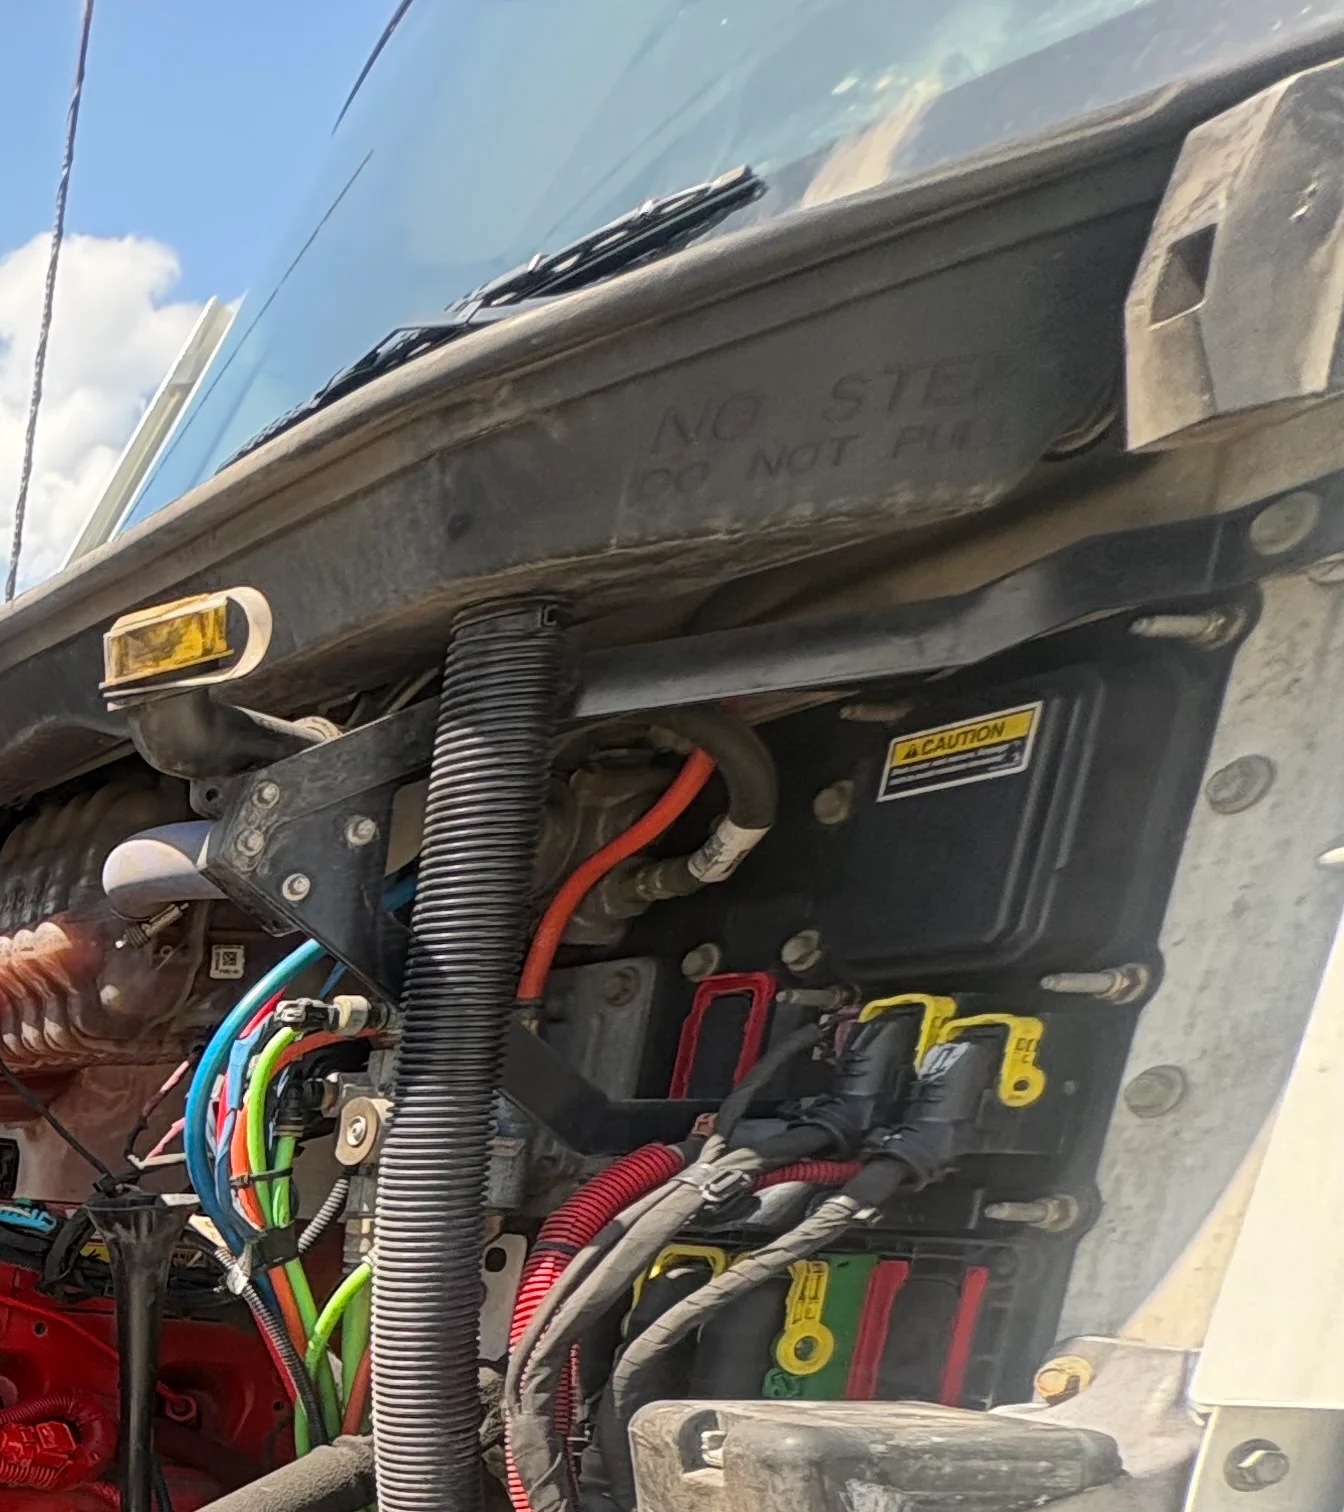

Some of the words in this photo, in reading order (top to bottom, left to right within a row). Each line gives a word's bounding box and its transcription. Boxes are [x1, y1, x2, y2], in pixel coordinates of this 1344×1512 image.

[652, 391, 765, 456] NO
[748, 434, 860, 481] NOT
[922, 721, 1006, 755] CAUTION
